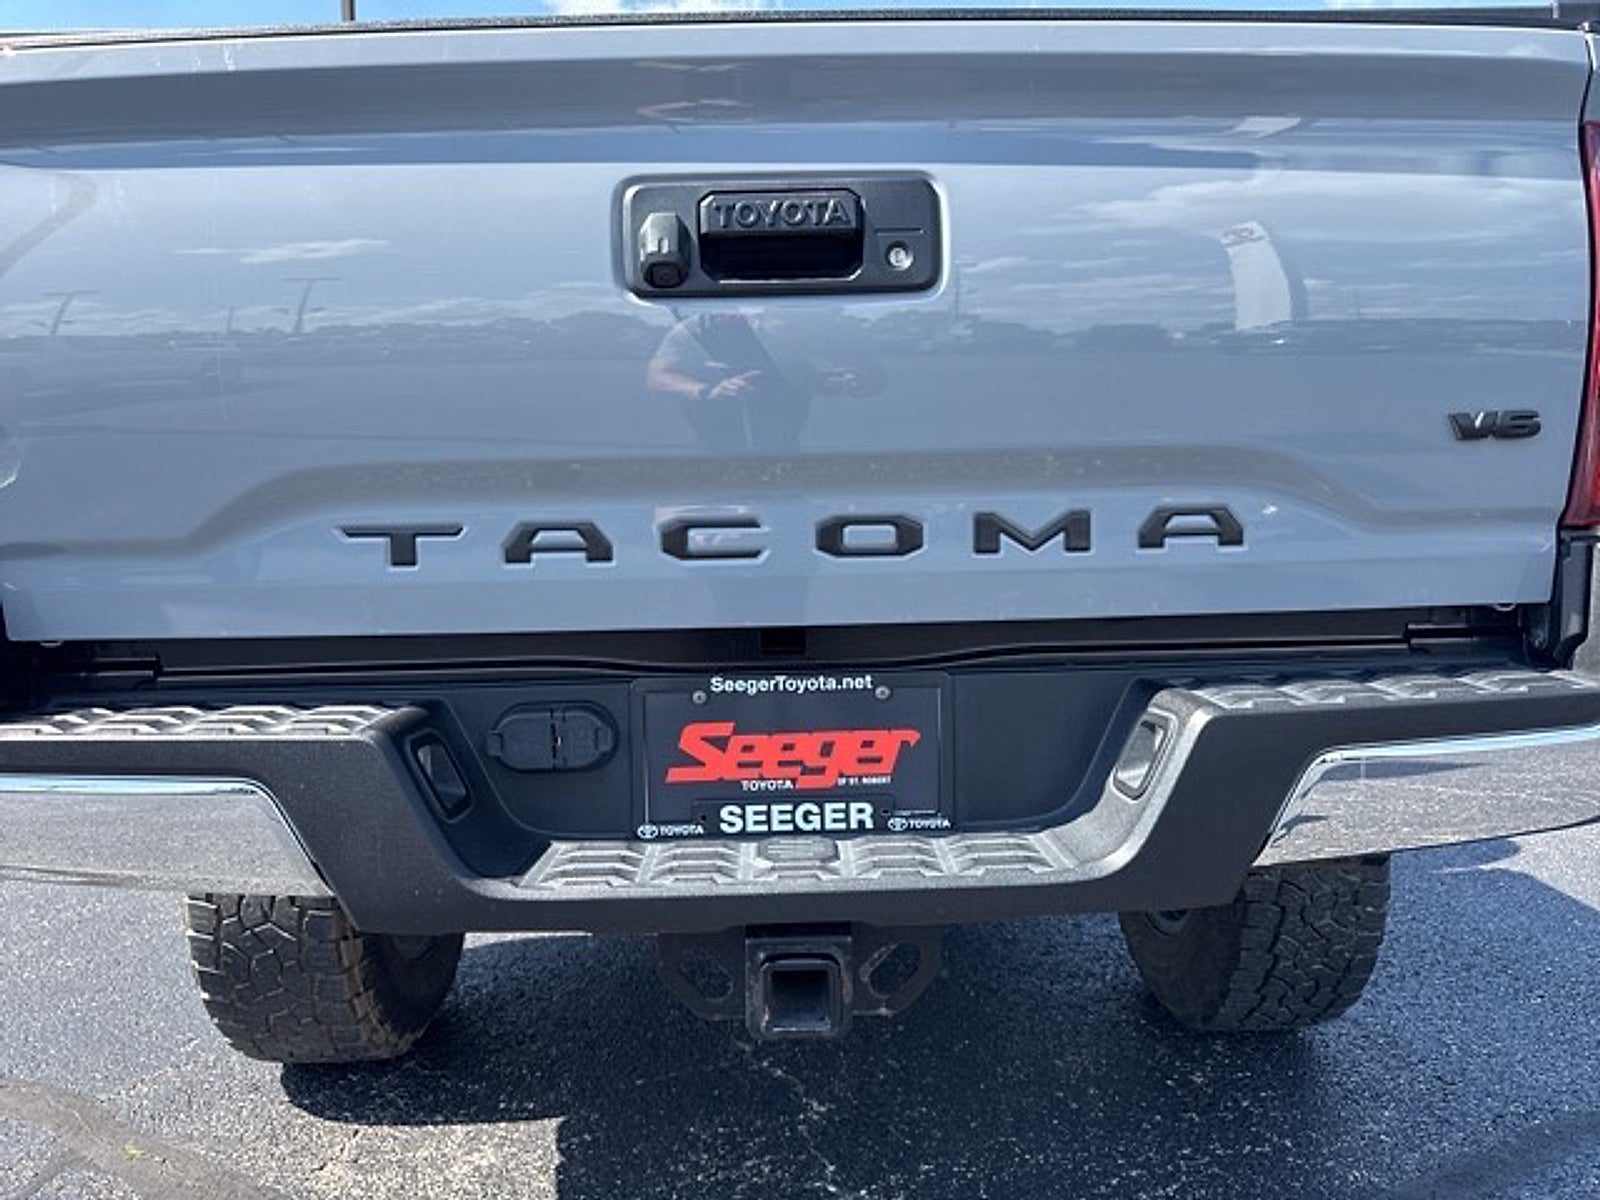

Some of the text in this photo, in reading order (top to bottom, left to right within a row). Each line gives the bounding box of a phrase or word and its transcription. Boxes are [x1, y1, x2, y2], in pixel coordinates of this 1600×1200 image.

[713, 199, 850, 229] TOYOTA
[1448, 410, 1541, 441] V6
[337, 505, 1245, 568] TACOMA
[710, 674, 873, 695] SeegerToyota.net
[665, 720, 921, 790] Seeger
[740, 779, 794, 791] TOYOTA
[659, 824, 705, 837] TOYOTA
[719, 802, 875, 833] SEEGER
[908, 817, 951, 829] TOYOTA
